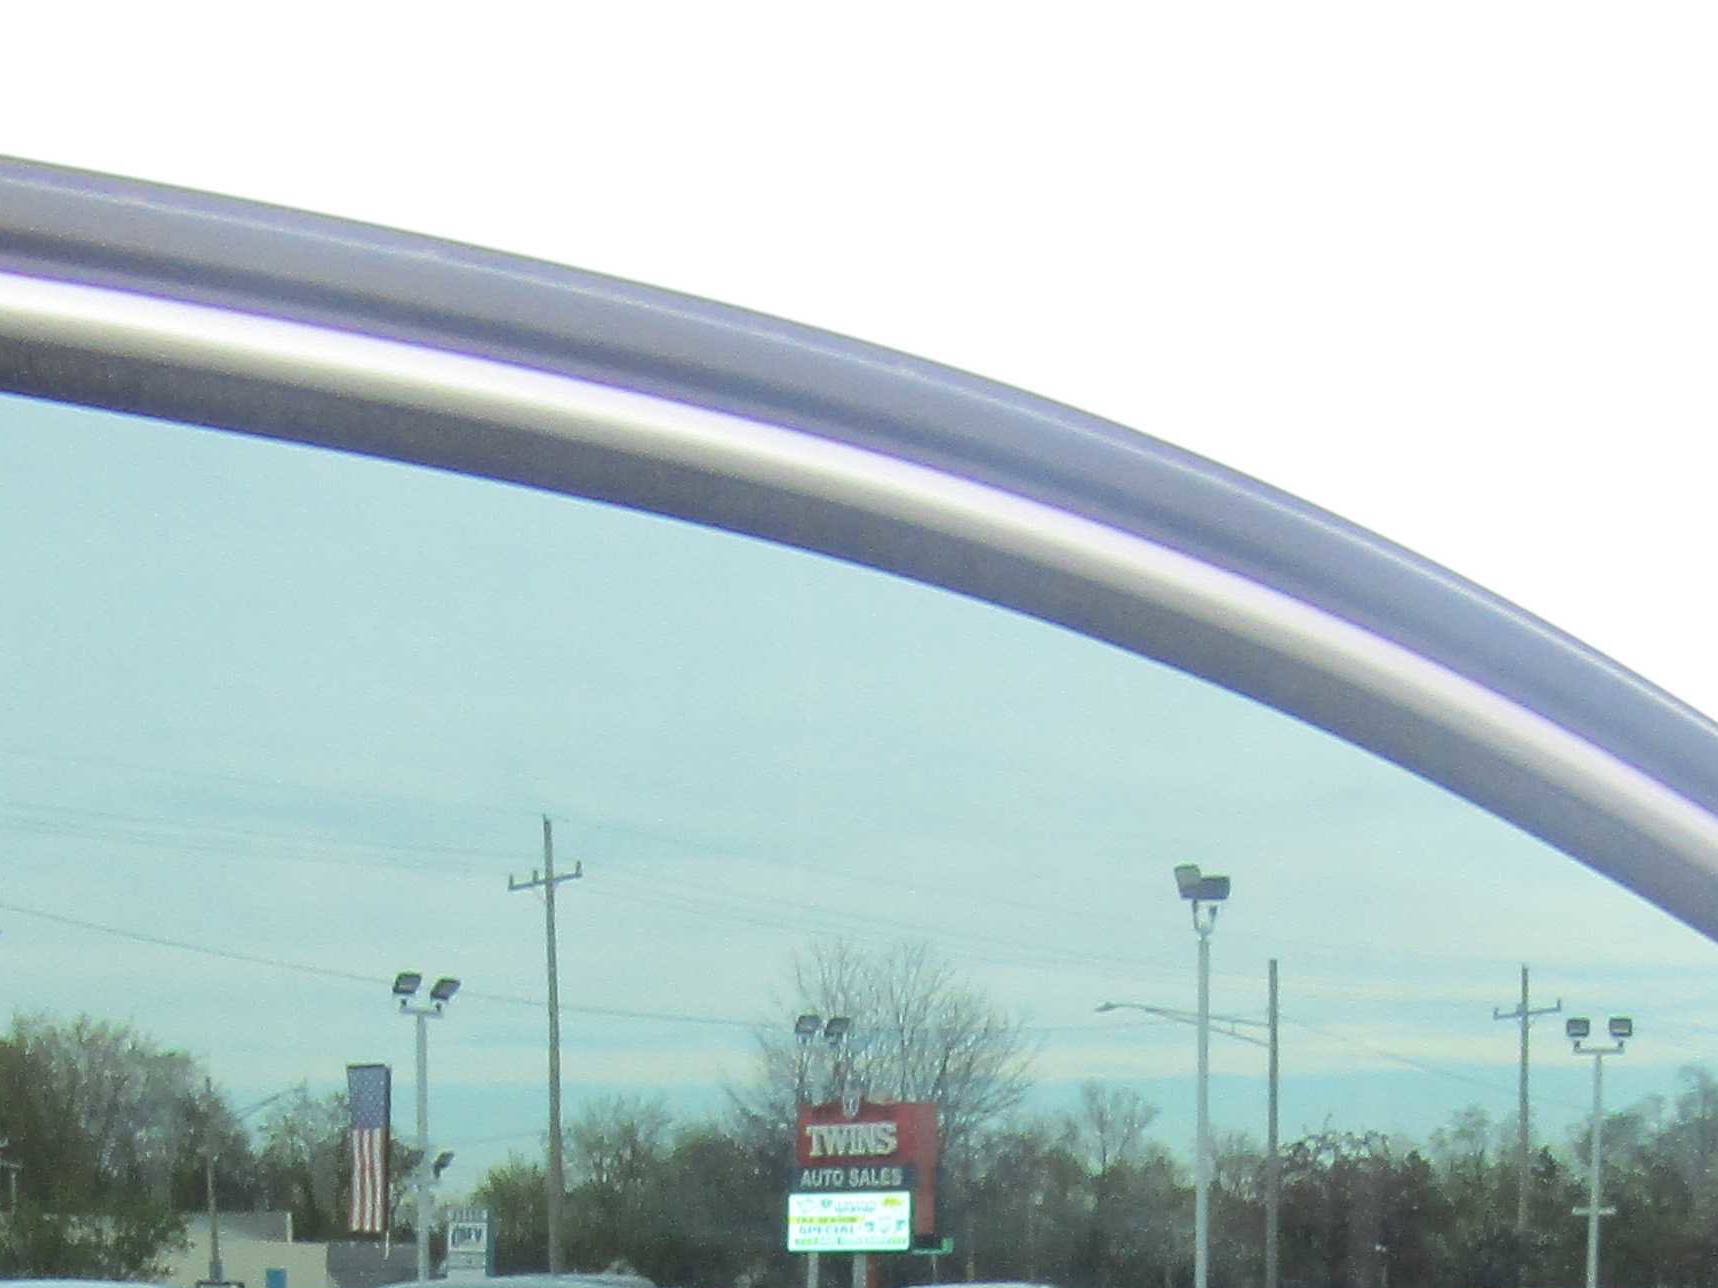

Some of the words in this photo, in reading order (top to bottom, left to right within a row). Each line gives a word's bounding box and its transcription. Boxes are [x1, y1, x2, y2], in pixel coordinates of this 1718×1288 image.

[805, 1121, 899, 1157] TWINS
[800, 1169, 844, 1187] AUTO
[849, 1168, 902, 1187] SALES
